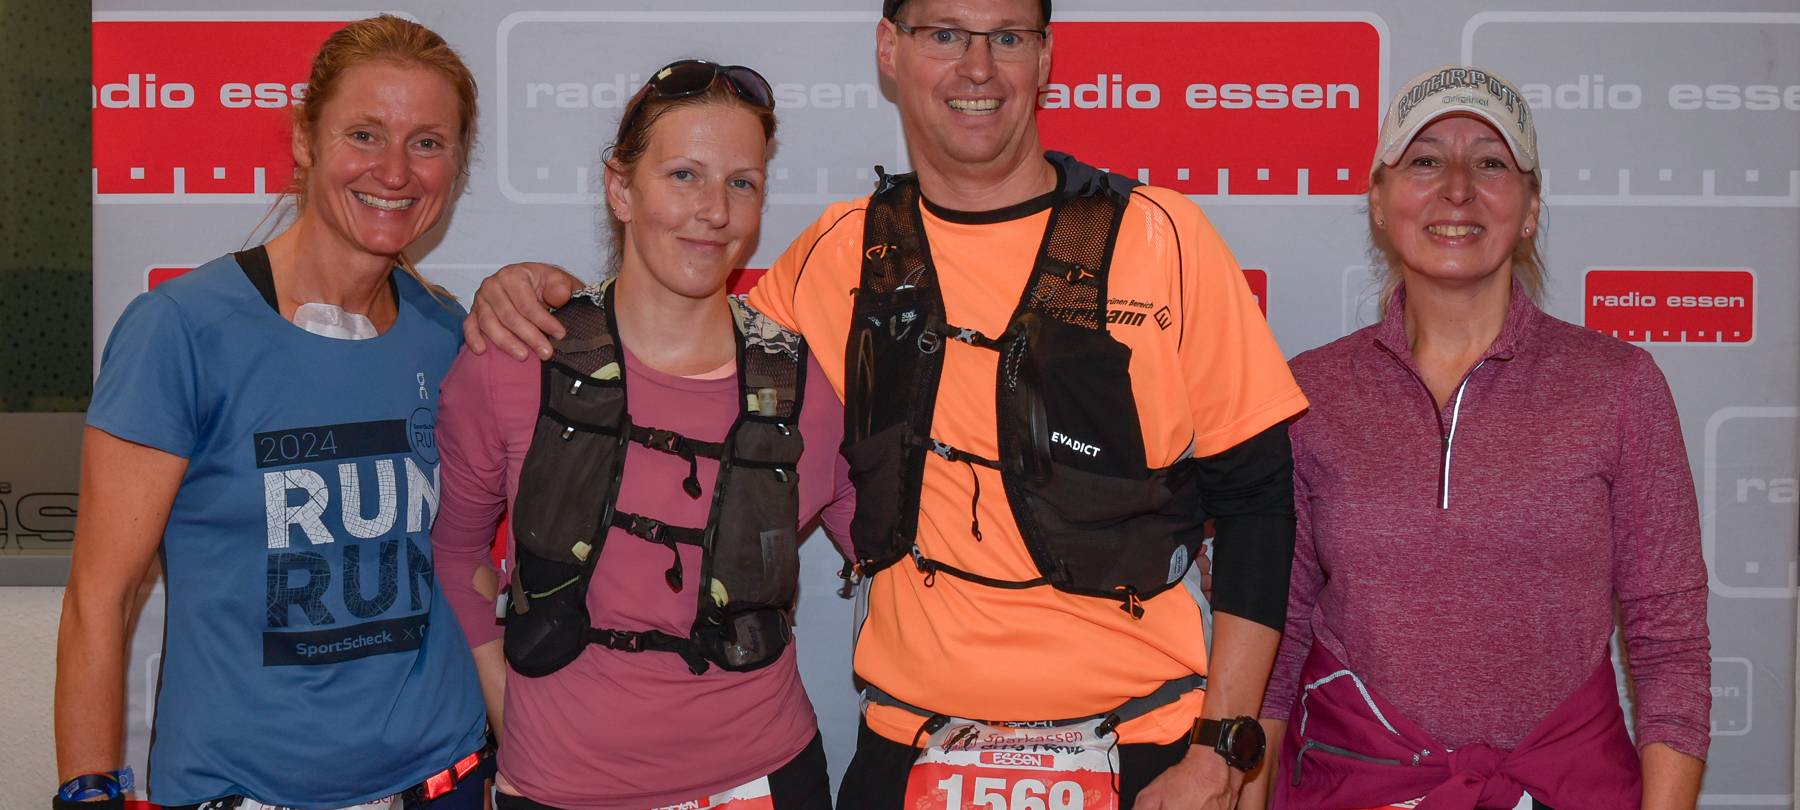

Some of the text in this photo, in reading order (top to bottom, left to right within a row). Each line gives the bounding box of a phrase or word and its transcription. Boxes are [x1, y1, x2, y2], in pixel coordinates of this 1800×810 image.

[92, 74, 195, 108] dio
[1186, 83, 1360, 109] essen
[1398, 68, 1528, 133] RUHRPOTT
[1592, 292, 1746, 307] radio essen
[260, 431, 338, 463] 2024
[1051, 431, 1101, 458] EVADICT
[296, 629, 393, 657] SportScheck
[937, 773, 1085, 810] 1569
